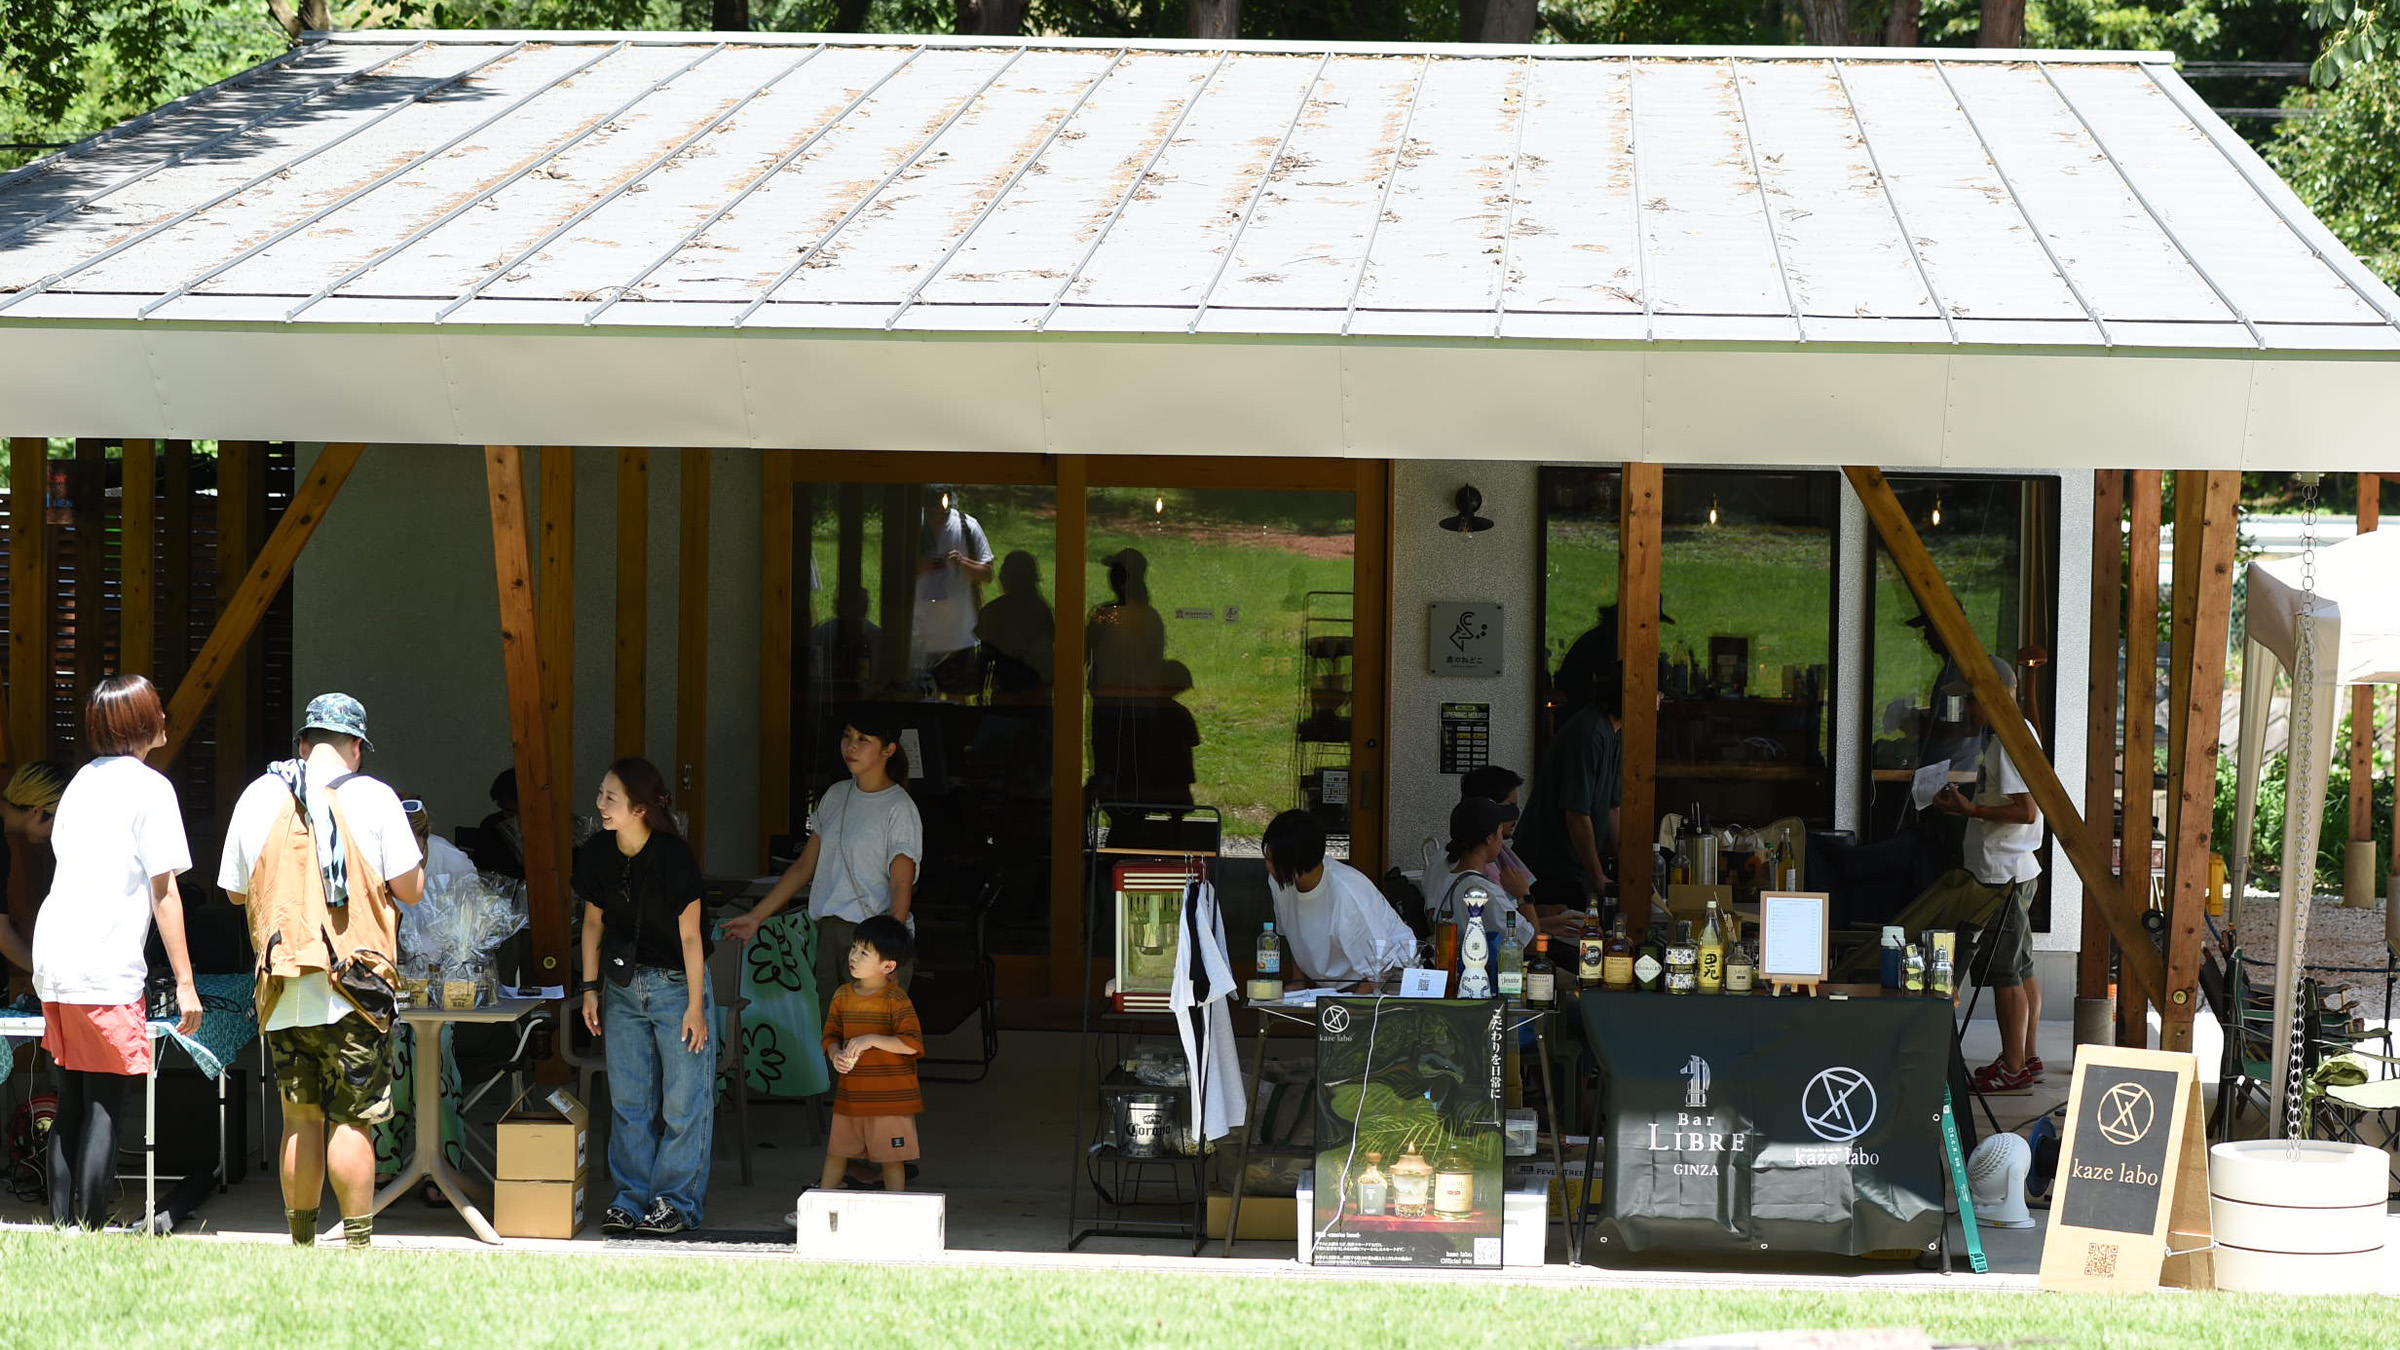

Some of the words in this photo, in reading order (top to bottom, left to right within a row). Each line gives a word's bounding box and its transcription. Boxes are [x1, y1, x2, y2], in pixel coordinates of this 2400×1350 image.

[1319, 1033, 1335, 1042] kaze
[1337, 1033, 1353, 1042] labo
[1489, 1008, 1503, 1099] こだわりを日常に
[1677, 1112, 1715, 1126] Bar
[1126, 1123, 1171, 1139] Corona
[1648, 1123, 1745, 1152] LIBRE
[1795, 1147, 1838, 1166] kaze
[1845, 1146, 1880, 1166] labo
[1673, 1163, 1720, 1176] GINZA
[2071, 1158, 2114, 1181] kaze
[2119, 1162, 2159, 1186] labo
